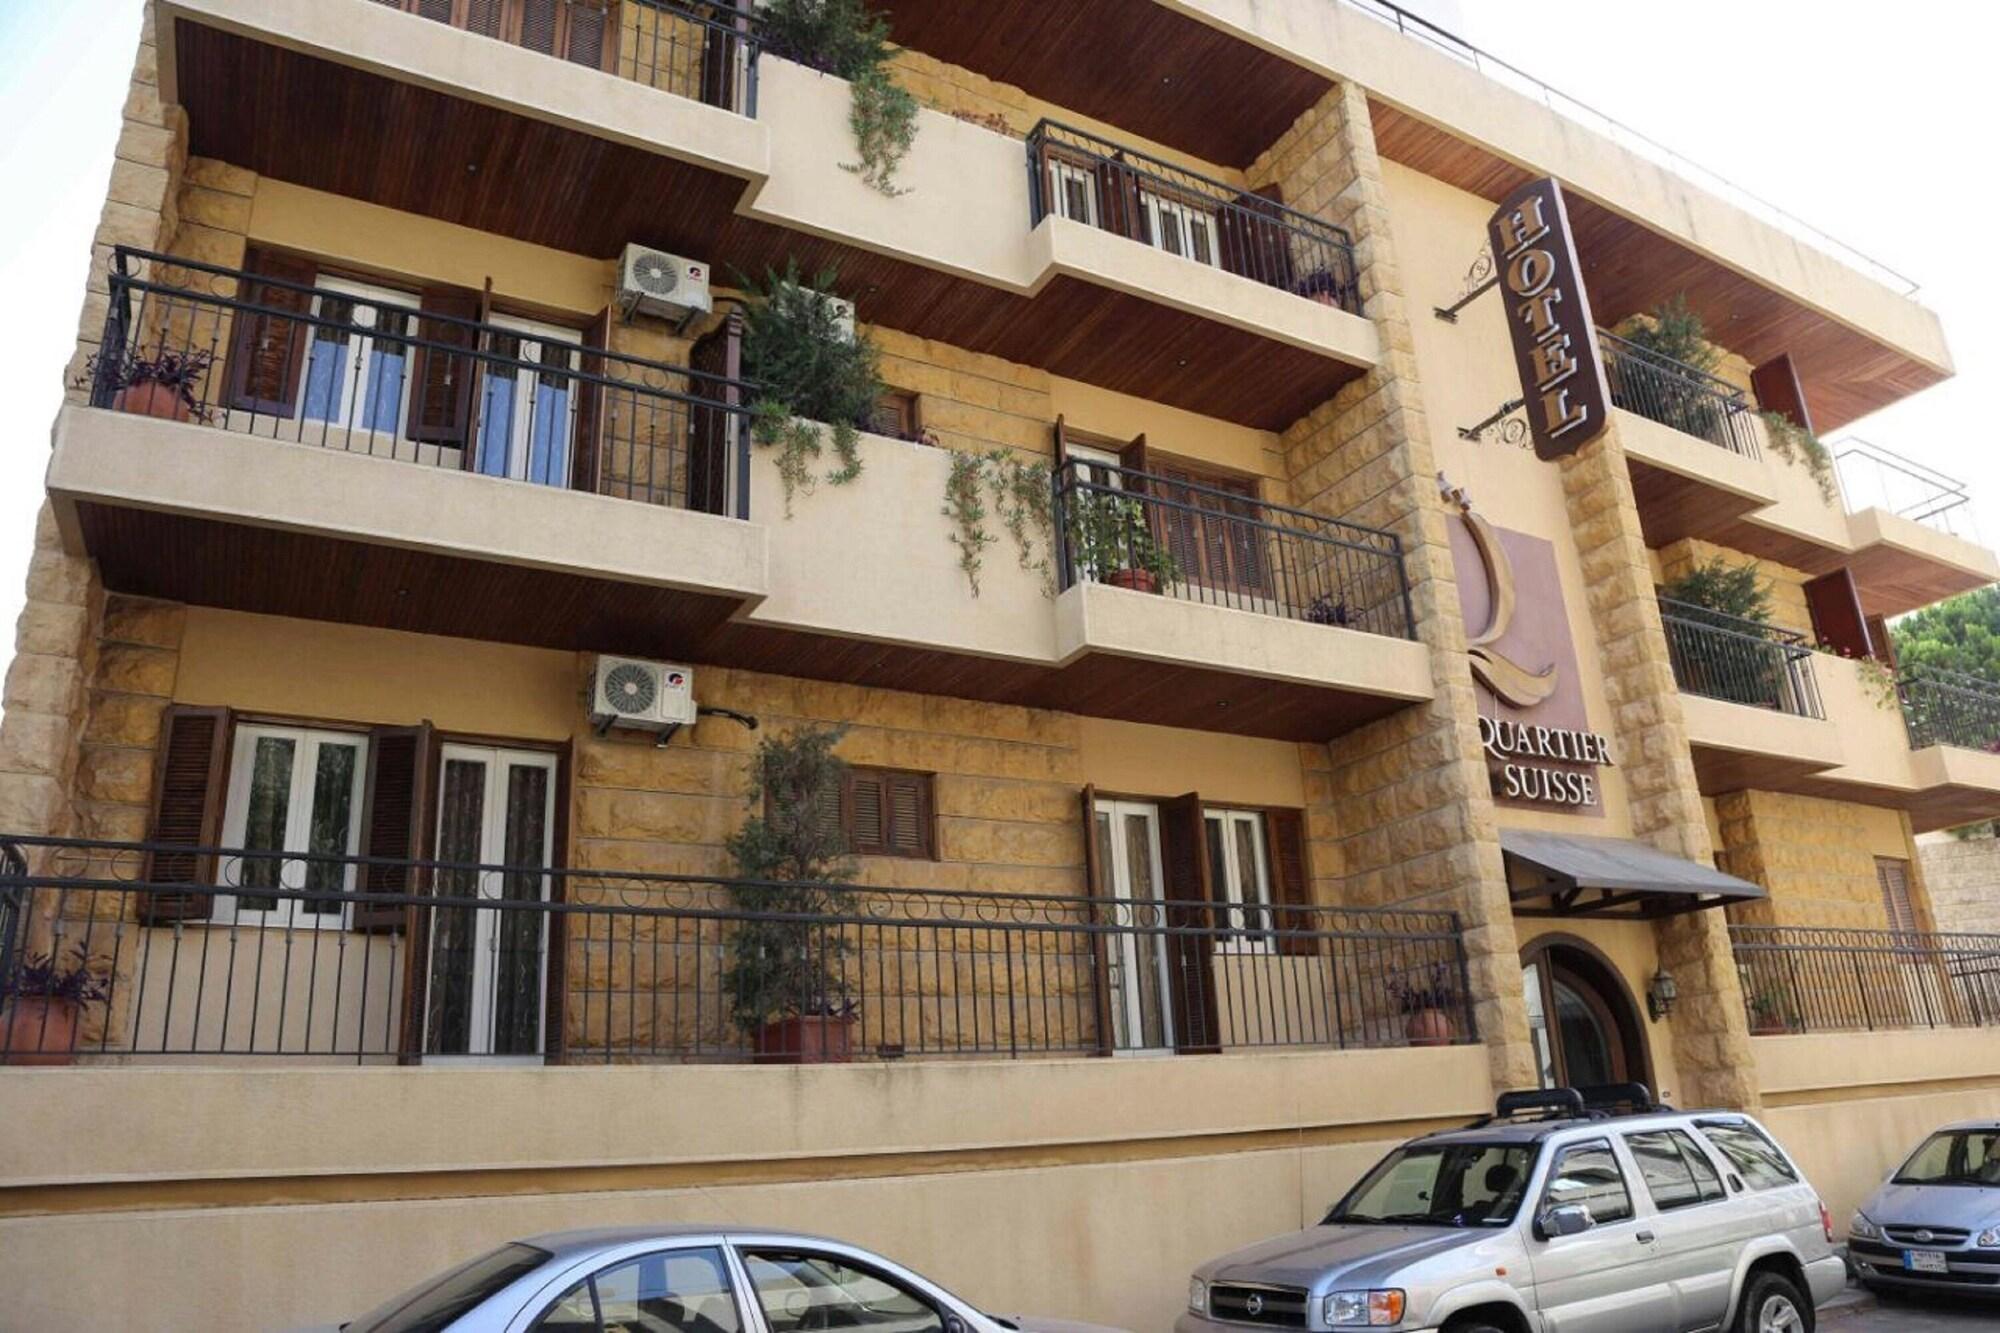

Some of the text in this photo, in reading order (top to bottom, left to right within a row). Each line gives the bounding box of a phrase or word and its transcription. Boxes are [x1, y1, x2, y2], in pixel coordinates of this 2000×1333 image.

[1496, 196, 1588, 438] HOTEL
[1478, 714, 1614, 766] QUARTIER
[1504, 763, 1597, 806] SUISSE
